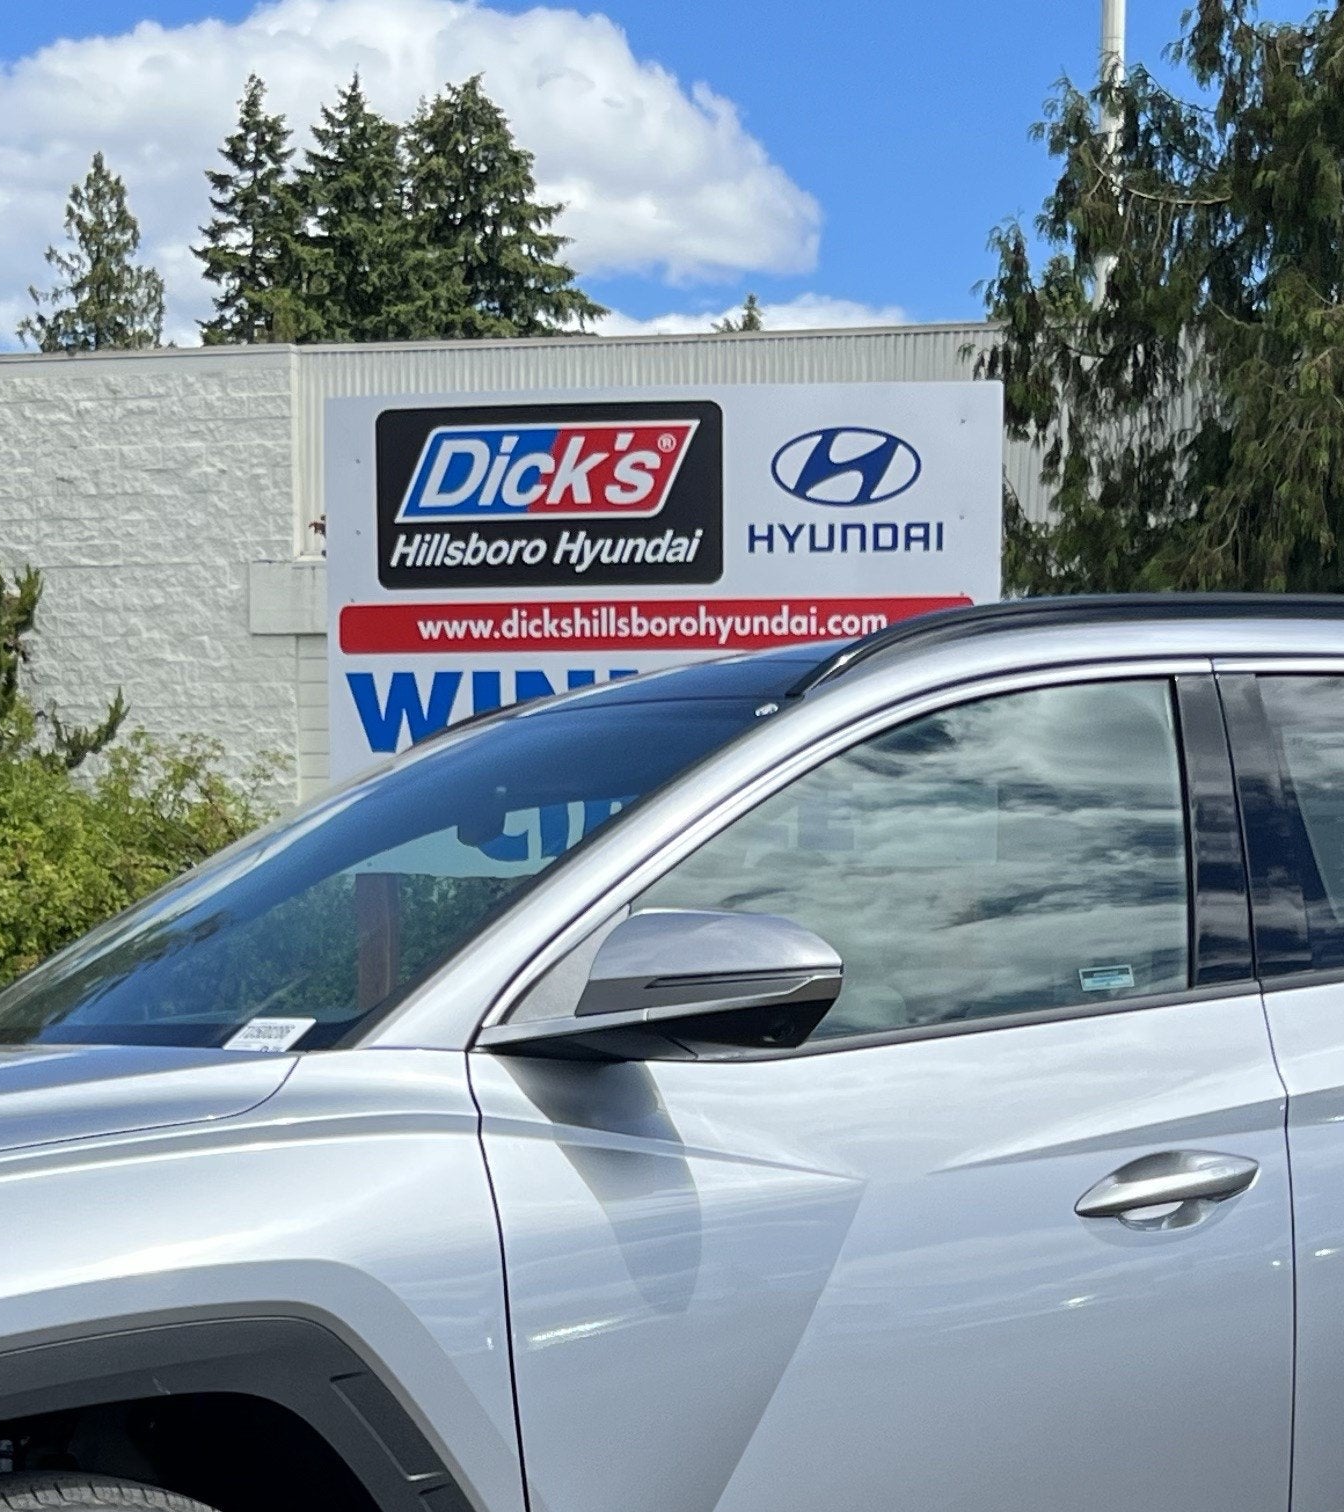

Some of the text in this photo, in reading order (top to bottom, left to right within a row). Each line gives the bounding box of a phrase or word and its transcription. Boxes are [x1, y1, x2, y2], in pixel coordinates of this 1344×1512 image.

[418, 430, 660, 511] Dick's
[389, 528, 703, 572] Hillsboro Hyundai
[748, 520, 944, 554] HYUNDAI
[416, 605, 888, 643] www.dickshillsborohyundai.com
